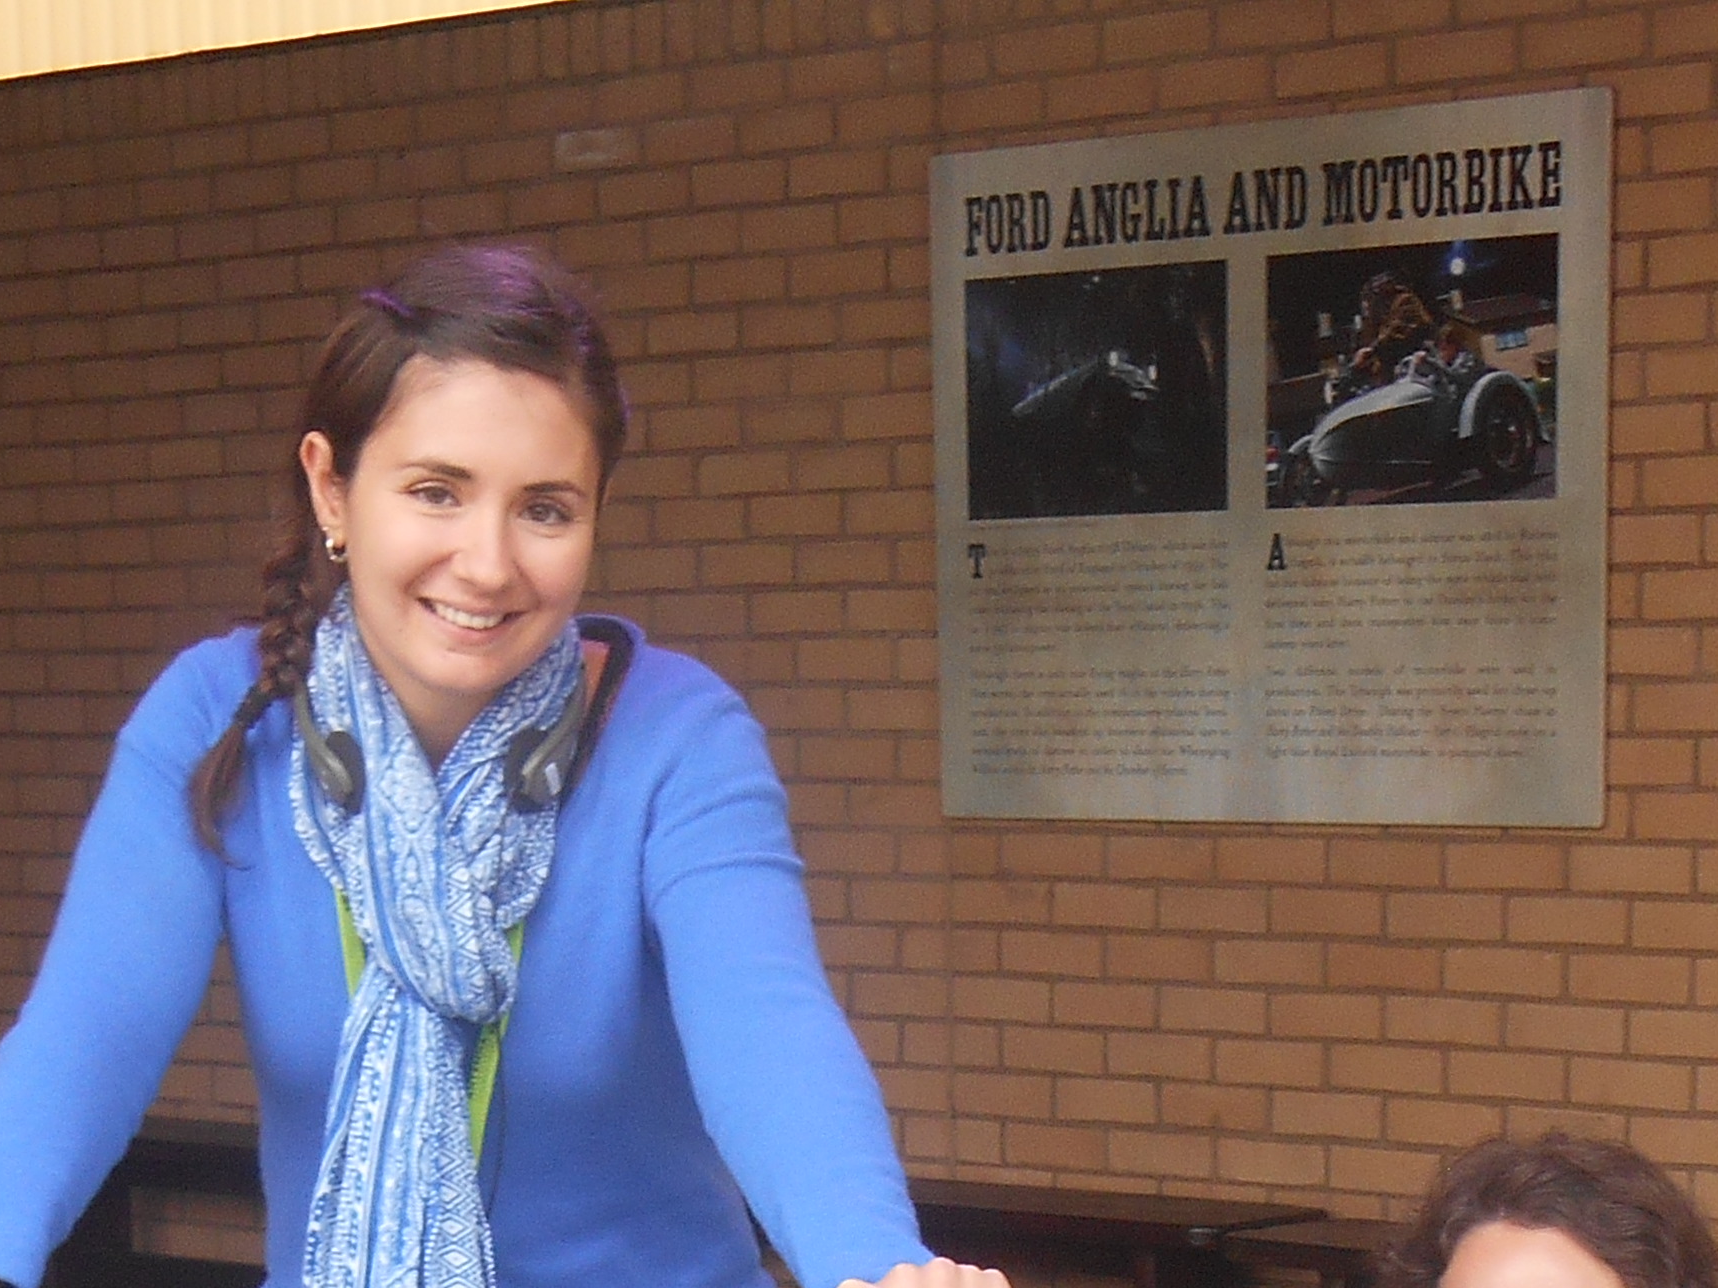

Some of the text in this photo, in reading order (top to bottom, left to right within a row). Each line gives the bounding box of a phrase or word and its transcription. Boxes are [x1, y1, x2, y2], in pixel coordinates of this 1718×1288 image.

[965, 140, 1562, 257] FORD ANGLIA AND MOTORBIKE
